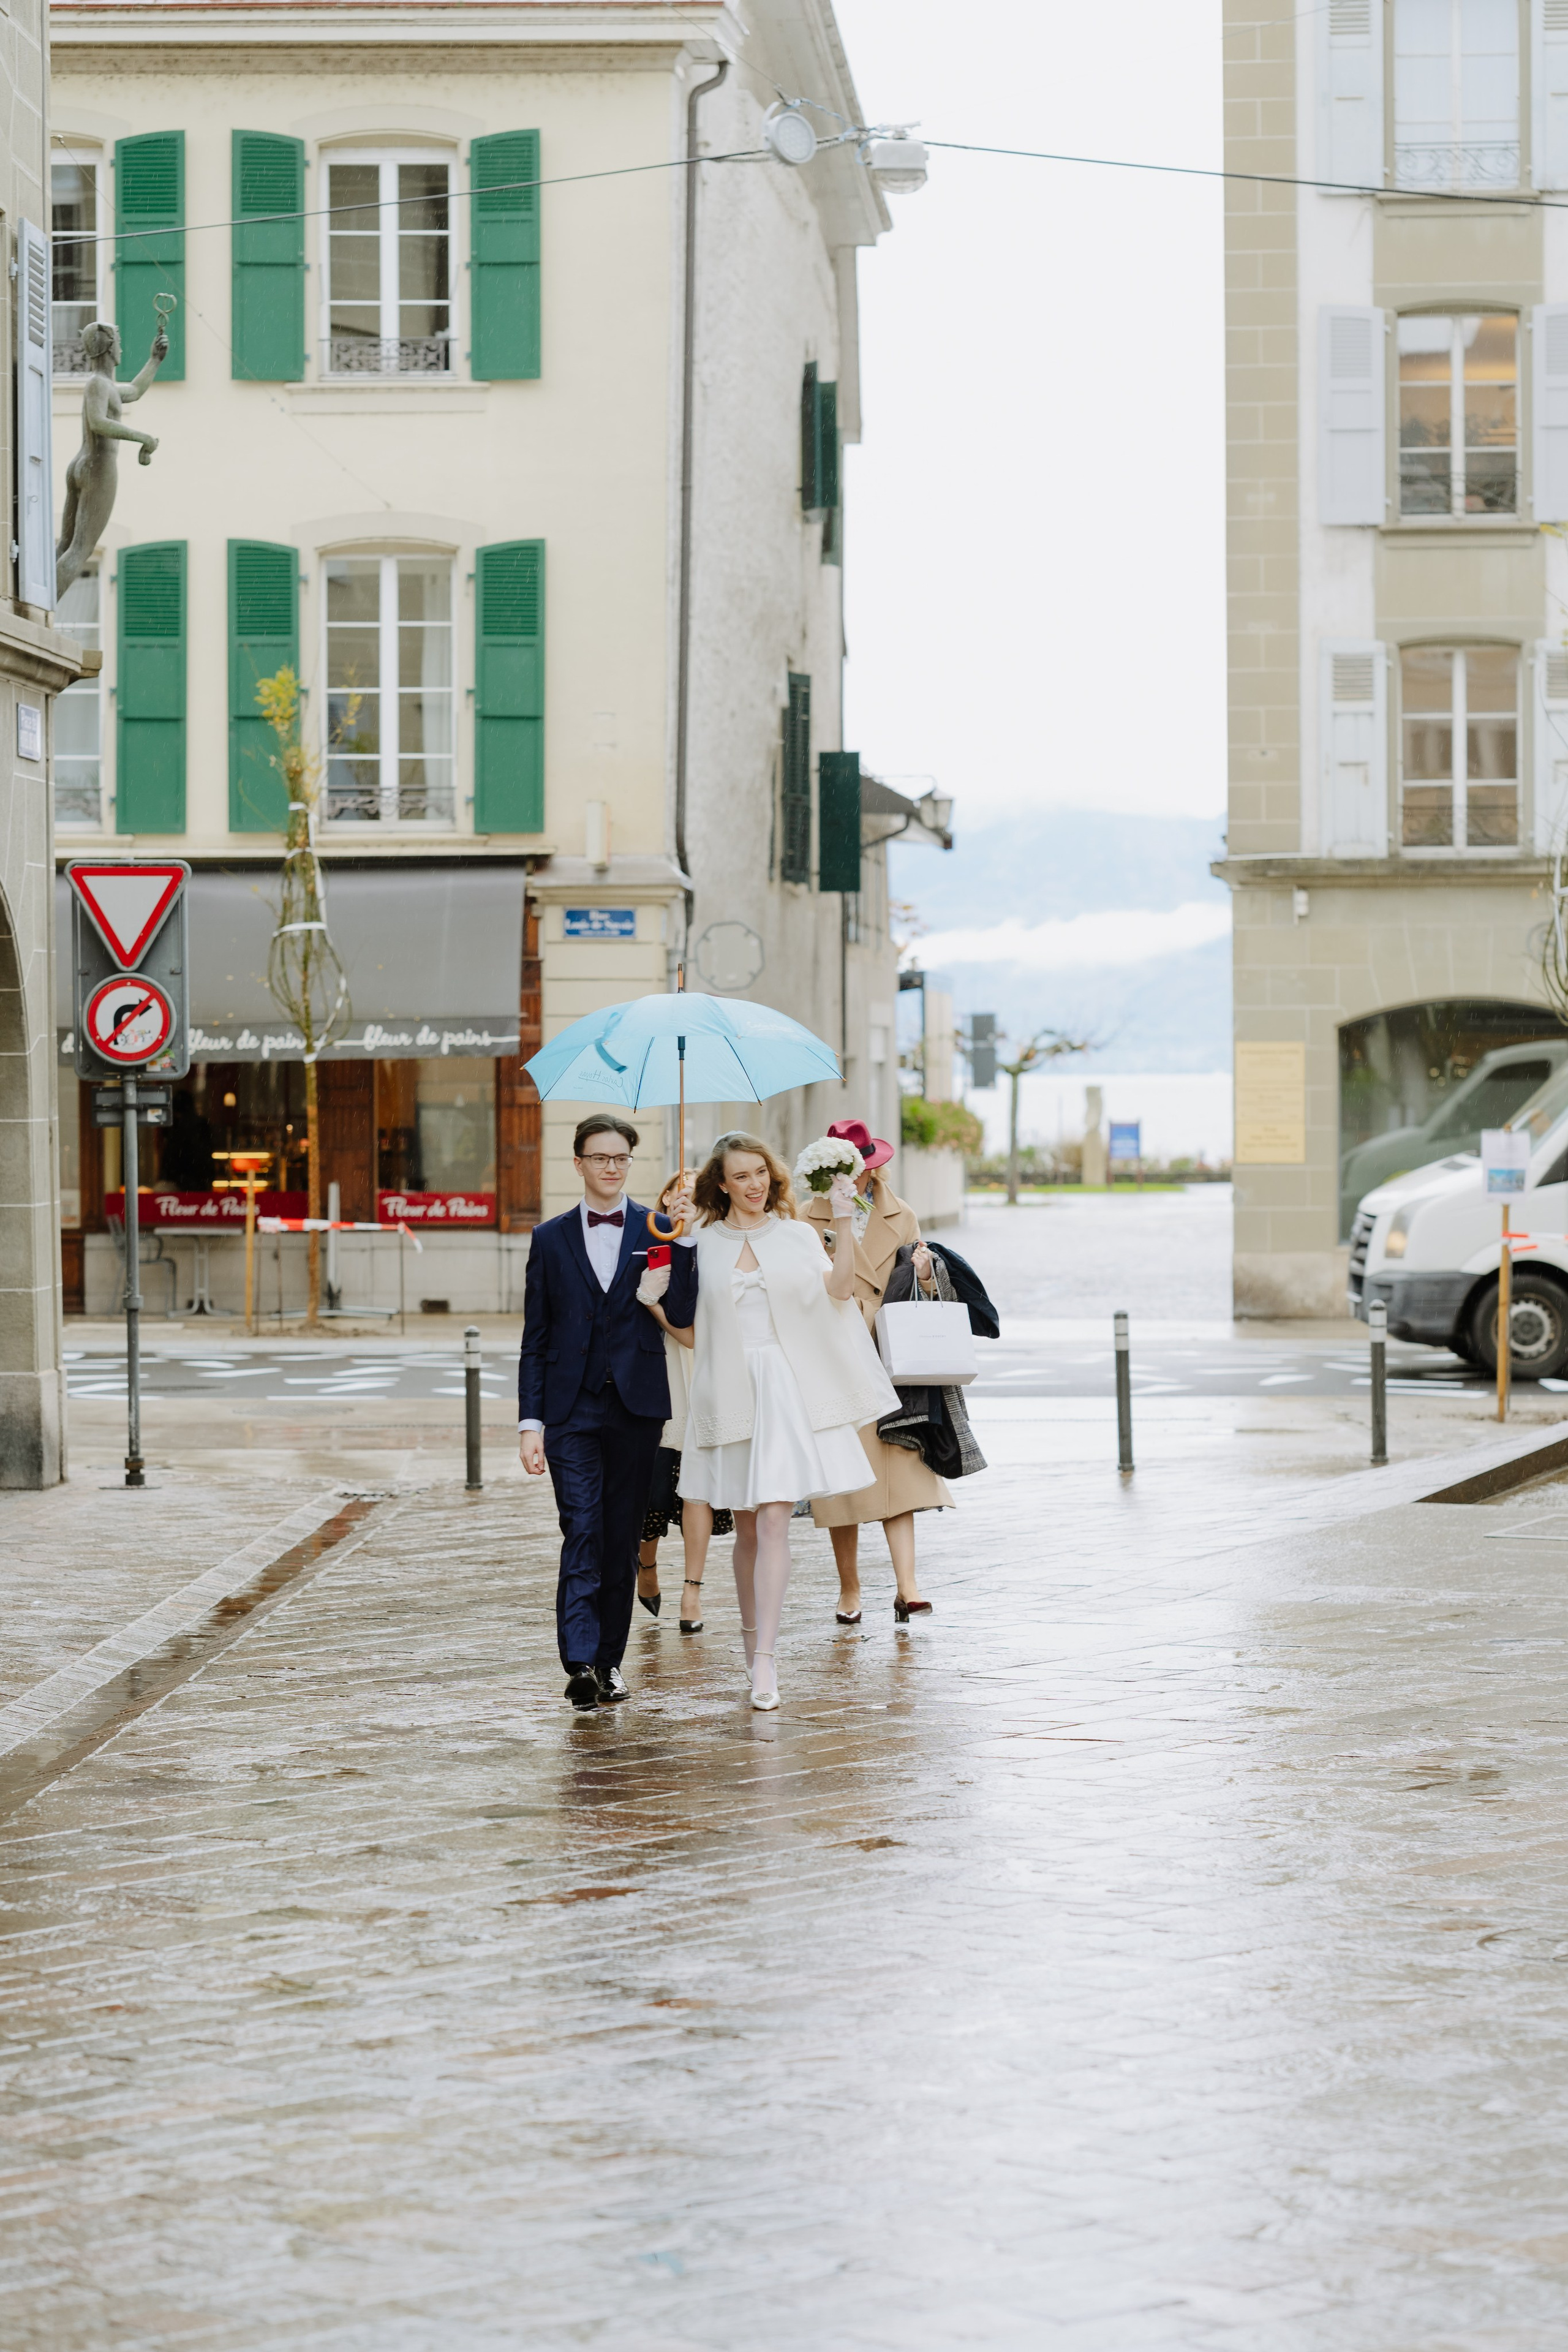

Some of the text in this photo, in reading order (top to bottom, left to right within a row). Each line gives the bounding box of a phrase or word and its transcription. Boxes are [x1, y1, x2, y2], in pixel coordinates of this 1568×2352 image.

[236, 1029, 260, 1050] de
[363, 1024, 492, 1055] fleur de pains
[154, 1196, 200, 1216] Fleur
[200, 1198, 219, 1216] de
[382, 1196, 489, 1218] Fleur de Pains
